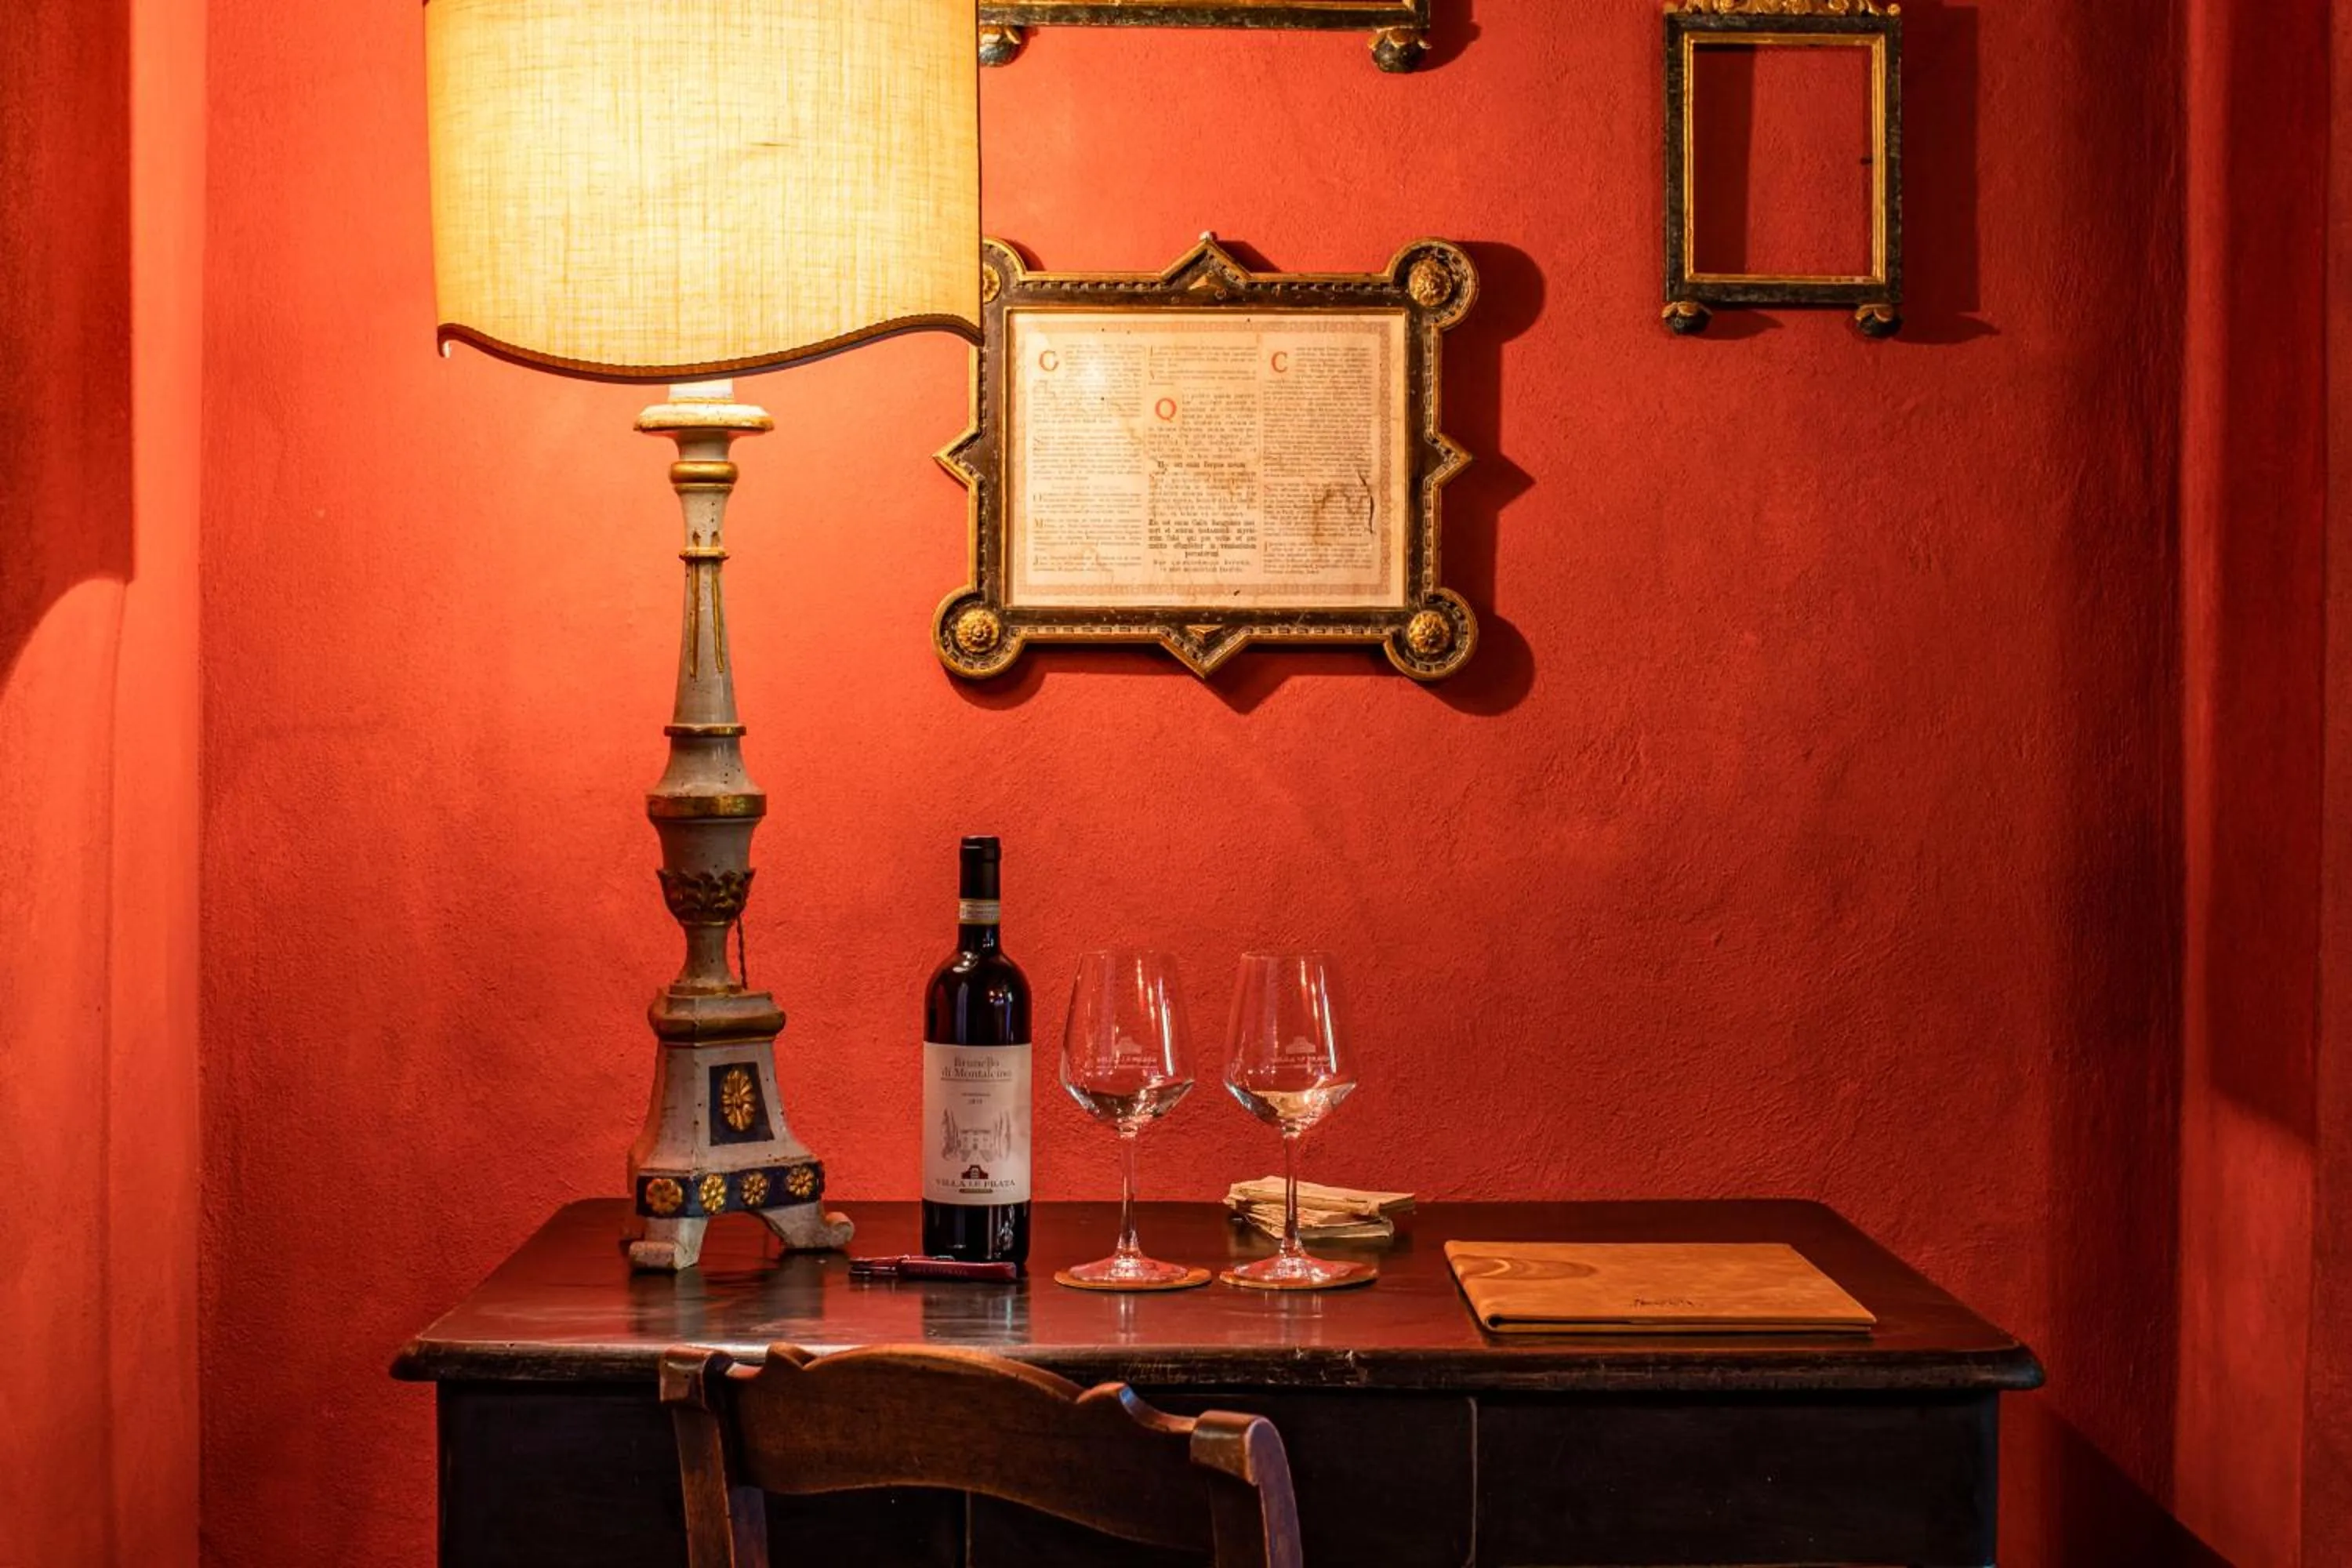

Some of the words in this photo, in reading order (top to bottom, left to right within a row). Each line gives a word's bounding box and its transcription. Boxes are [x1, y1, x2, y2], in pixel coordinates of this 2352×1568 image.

[1039, 350, 1059, 372] C
[1271, 350, 1288, 373] C
[1154, 397, 1177, 423] Q
[954, 1057, 1000, 1067] Brunello
[954, 1067, 1012, 1077] Montalcino
[984, 1179, 1015, 1188] PRATA
